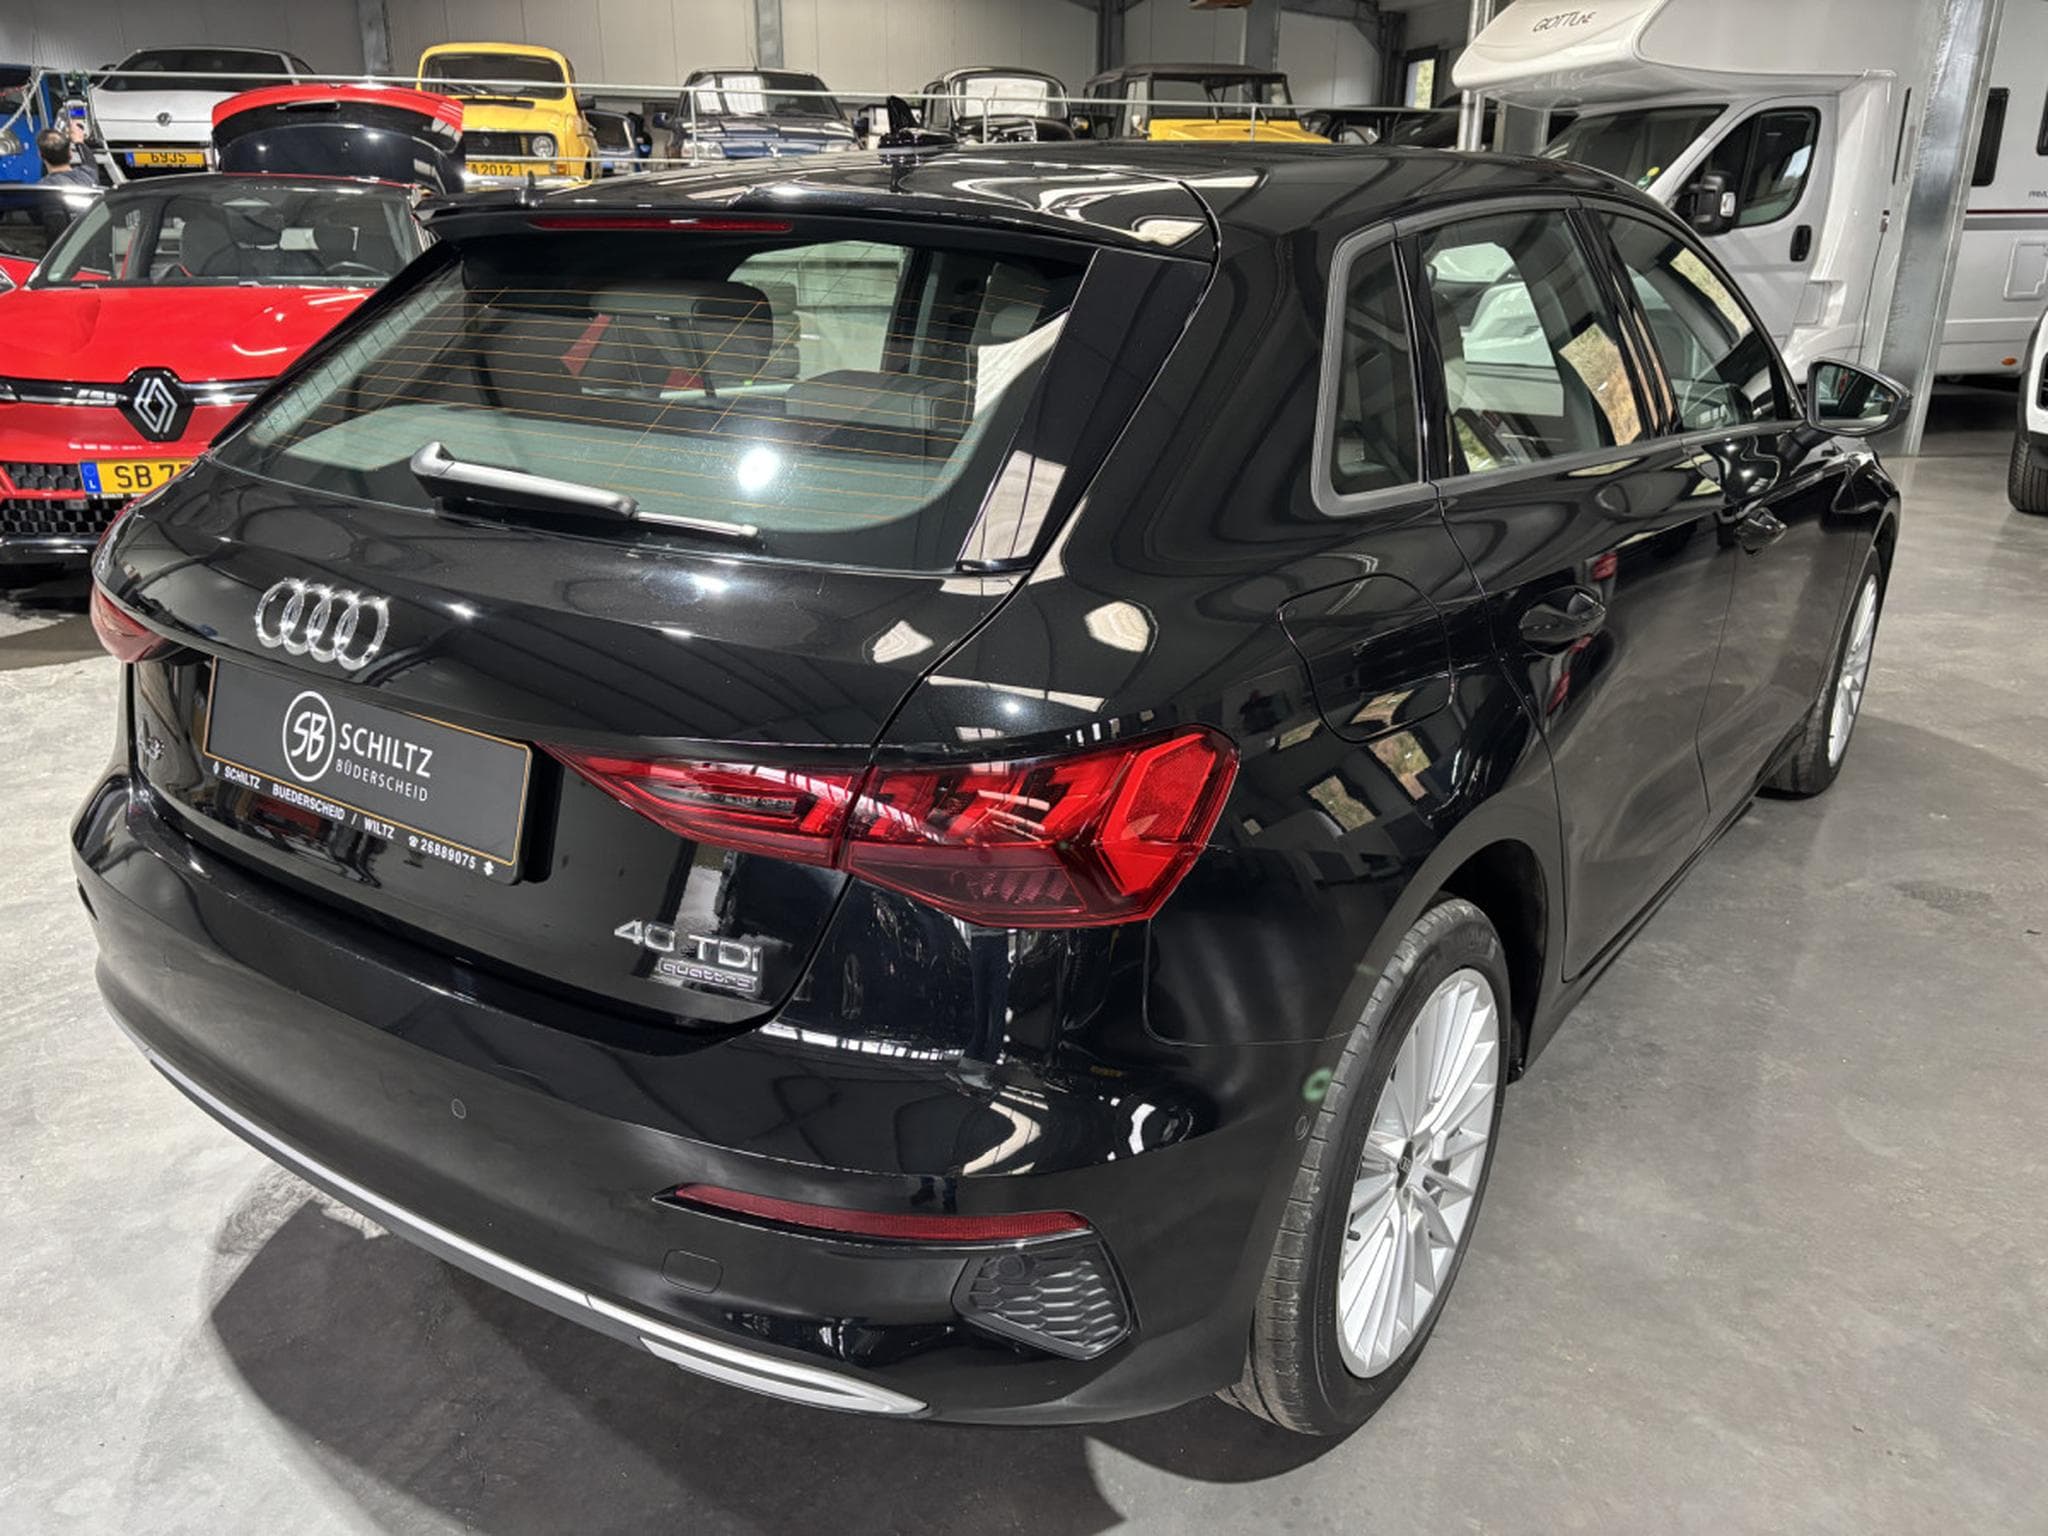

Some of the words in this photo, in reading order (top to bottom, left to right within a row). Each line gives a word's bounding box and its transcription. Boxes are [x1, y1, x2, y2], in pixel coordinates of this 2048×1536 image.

[88, 480, 97, 489] L
[114, 464, 153, 488] SB
[338, 722, 434, 778] SCHILTZ
[335, 758, 428, 802] BÜDERSCHEID
[223, 765, 260, 789] SCHILTZ
[272, 783, 346, 820] BUEDERSCHEID
[363, 817, 395, 840] WILTZ
[420, 838, 477, 870] 26889075
[613, 919, 676, 953] 40
[687, 934, 762, 973] TDI
[662, 962, 752, 988] quattro
